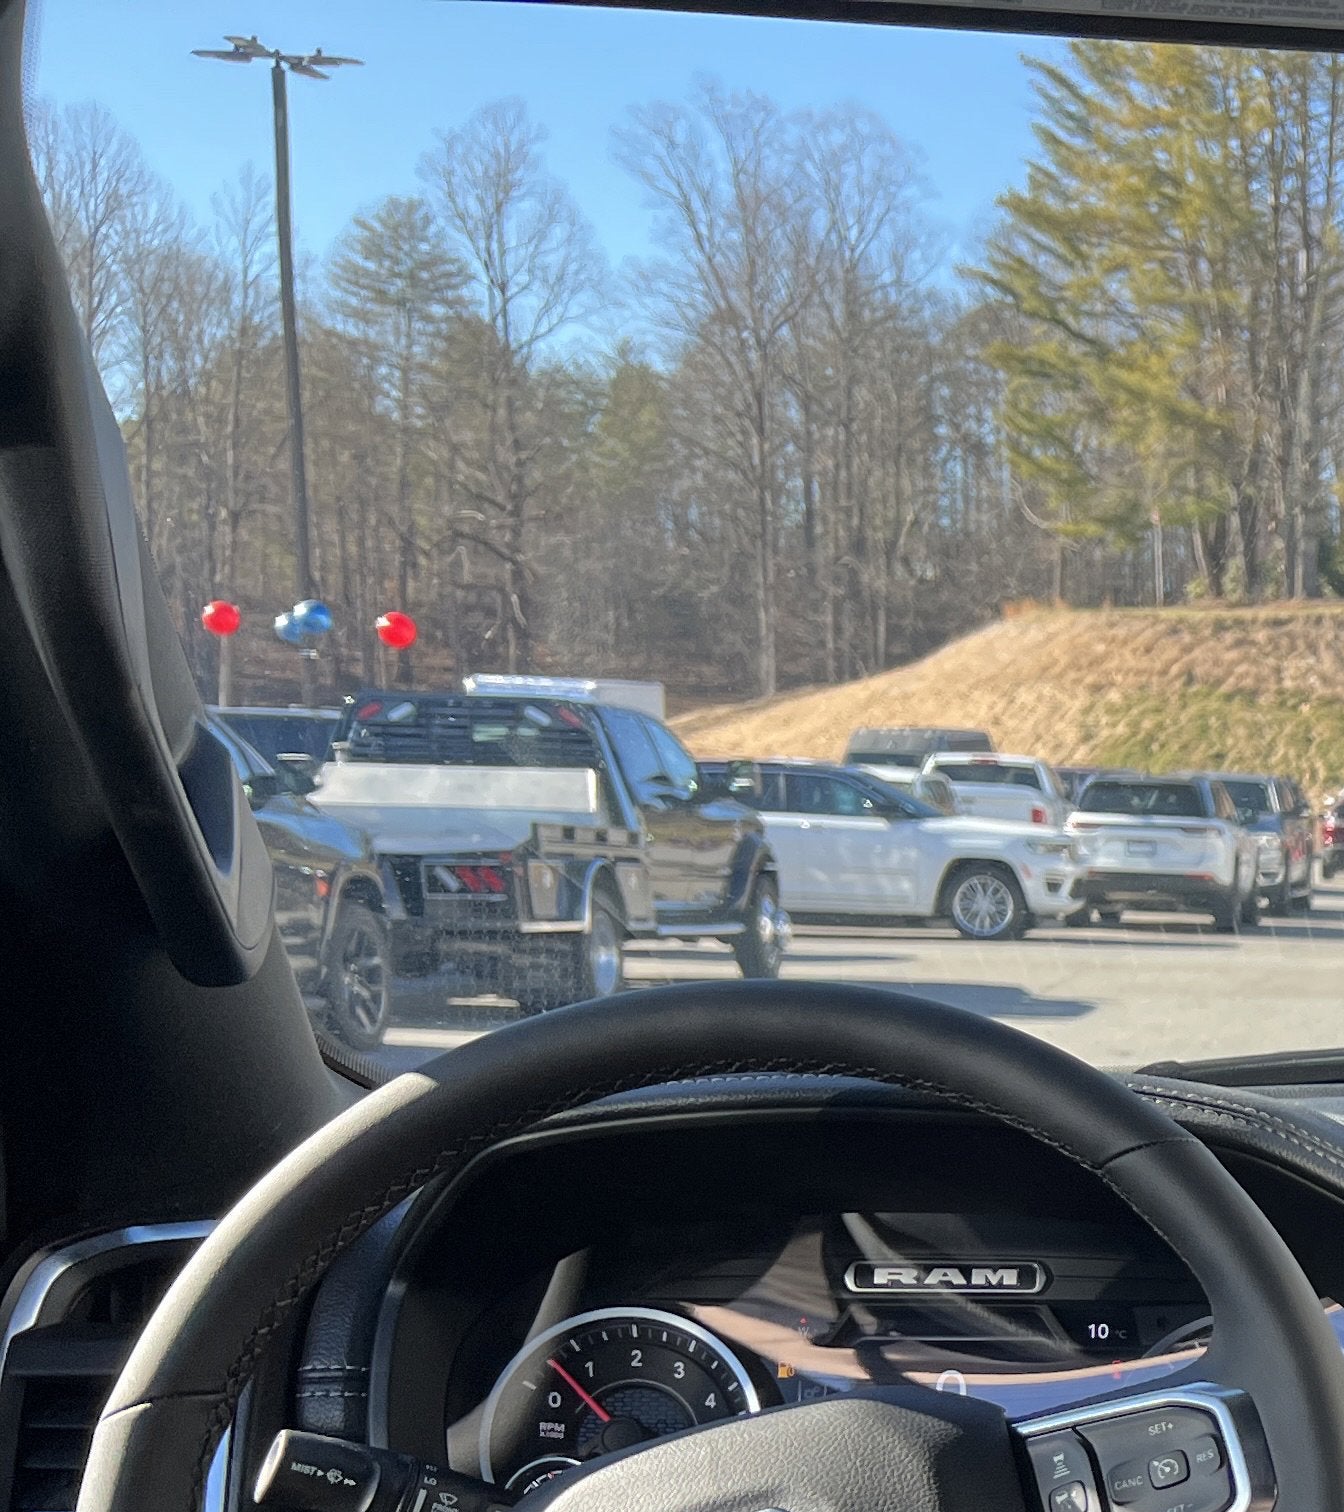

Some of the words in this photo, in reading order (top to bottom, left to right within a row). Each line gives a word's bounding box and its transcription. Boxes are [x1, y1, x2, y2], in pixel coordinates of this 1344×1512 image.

[873, 1266, 1019, 1286] RAM
[1088, 1323, 1109, 1339] 10
[630, 1349, 643, 1367] 2
[584, 1361, 594, 1377] 1
[673, 1361, 686, 1379] 3
[548, 1391, 562, 1408] 0
[704, 1392, 717, 1409] 4
[539, 1422, 565, 1433] RPM
[1196, 1450, 1214, 1463] RES
[290, 1462, 317, 1477] MIST
[1114, 1475, 1144, 1490] CANC
